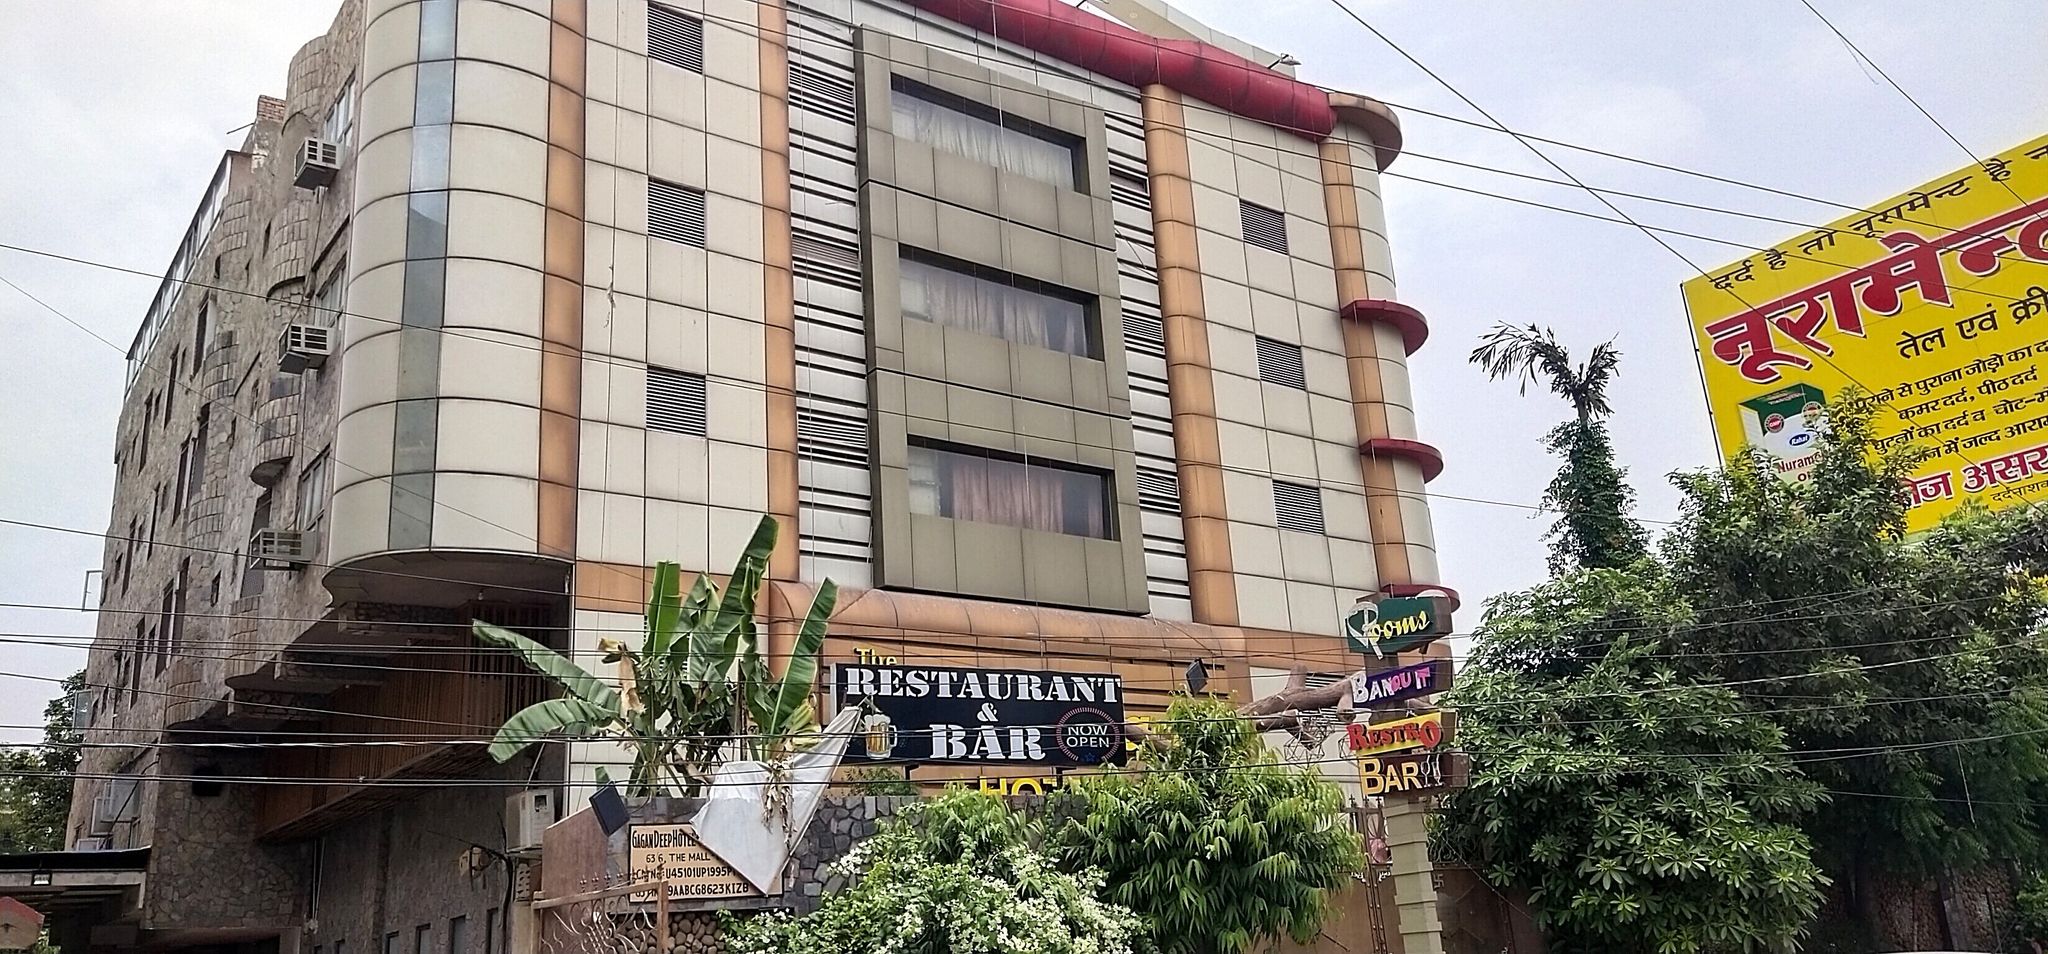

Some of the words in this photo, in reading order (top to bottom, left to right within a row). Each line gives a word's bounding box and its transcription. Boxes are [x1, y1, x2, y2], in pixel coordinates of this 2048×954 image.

[1710, 260, 1755, 290] दर्द
[1798, 229, 1838, 256] तो
[1848, 176, 1973, 239] नूरामेन्ट
[1896, 327, 1946, 360] तेल
[1955, 303, 1998, 340] एवं
[1896, 383, 1913, 398] से
[1914, 367, 1962, 395] पुराना
[2006, 345, 2033, 362] का
[1898, 399, 1941, 420] कमर
[1976, 377, 2009, 395] पीठ
[2009, 364, 2038, 385] दर्द
[1916, 422, 1942, 438] का
[1942, 410, 1969, 430] दर्द
[1970, 409, 1986, 421] व
[1943, 436, 1959, 454] में
[1961, 429, 2001, 449] जल्द
[1346, 601, 1431, 660] Rooms
[853, 648, 898, 666] The
[844, 667, 1122, 704] RESTAURANT
[976, 702, 999, 722] &
[929, 723, 1047, 761] BAR
[1065, 736, 1111, 749] OPEN
[1067, 724, 1109, 737] NOW
[1346, 720, 1443, 751] RESTRO
[1359, 758, 1423, 796] BAR
[668, 853, 686, 862] THE
[688, 852, 711, 861] MALL
